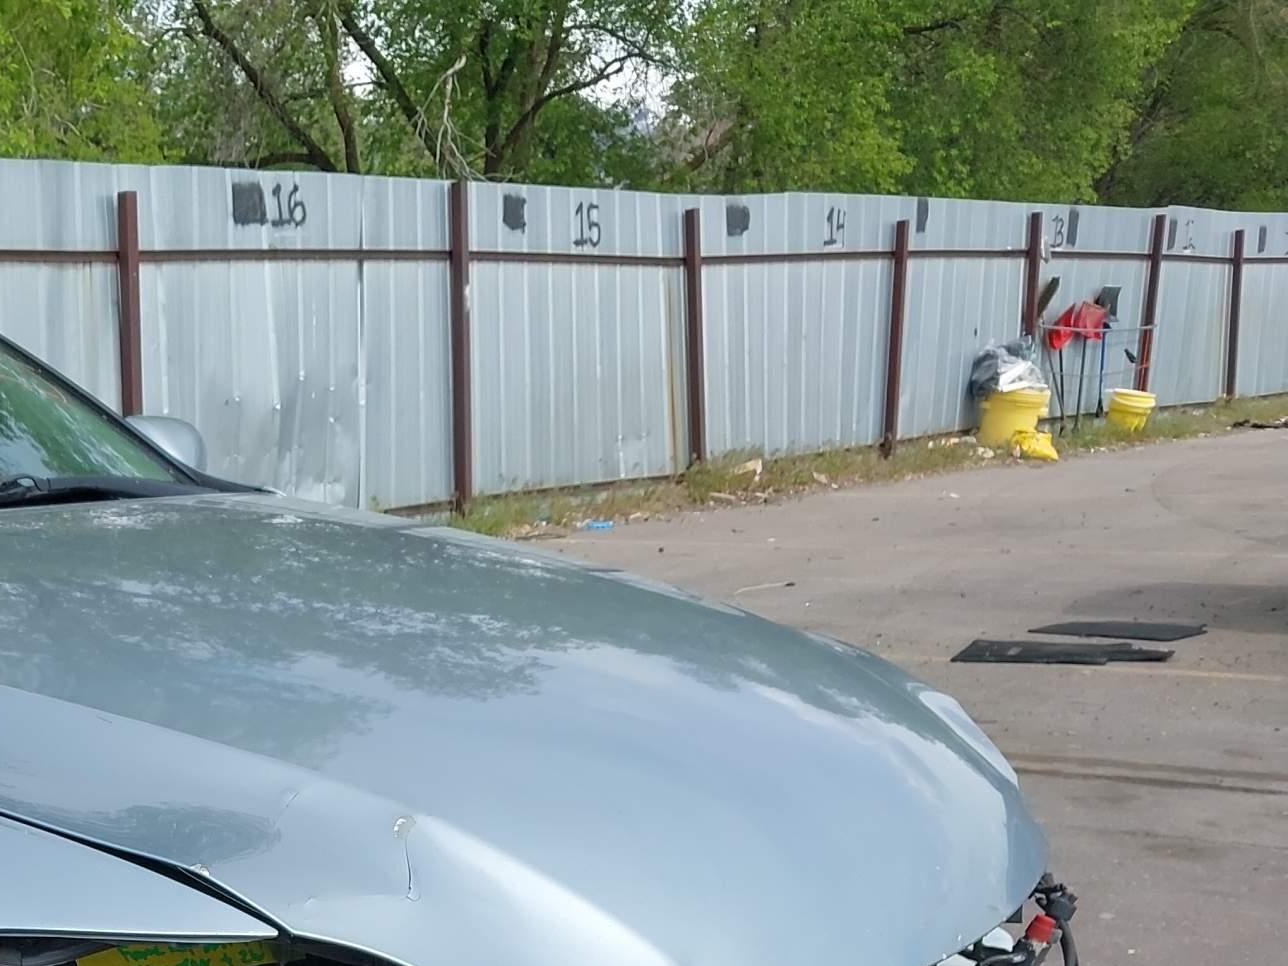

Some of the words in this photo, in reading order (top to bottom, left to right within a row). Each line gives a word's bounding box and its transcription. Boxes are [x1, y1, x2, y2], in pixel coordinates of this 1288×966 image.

[270, 183, 307, 226] 16
[572, 200, 602, 247] 15
[822, 205, 847, 243] 14
